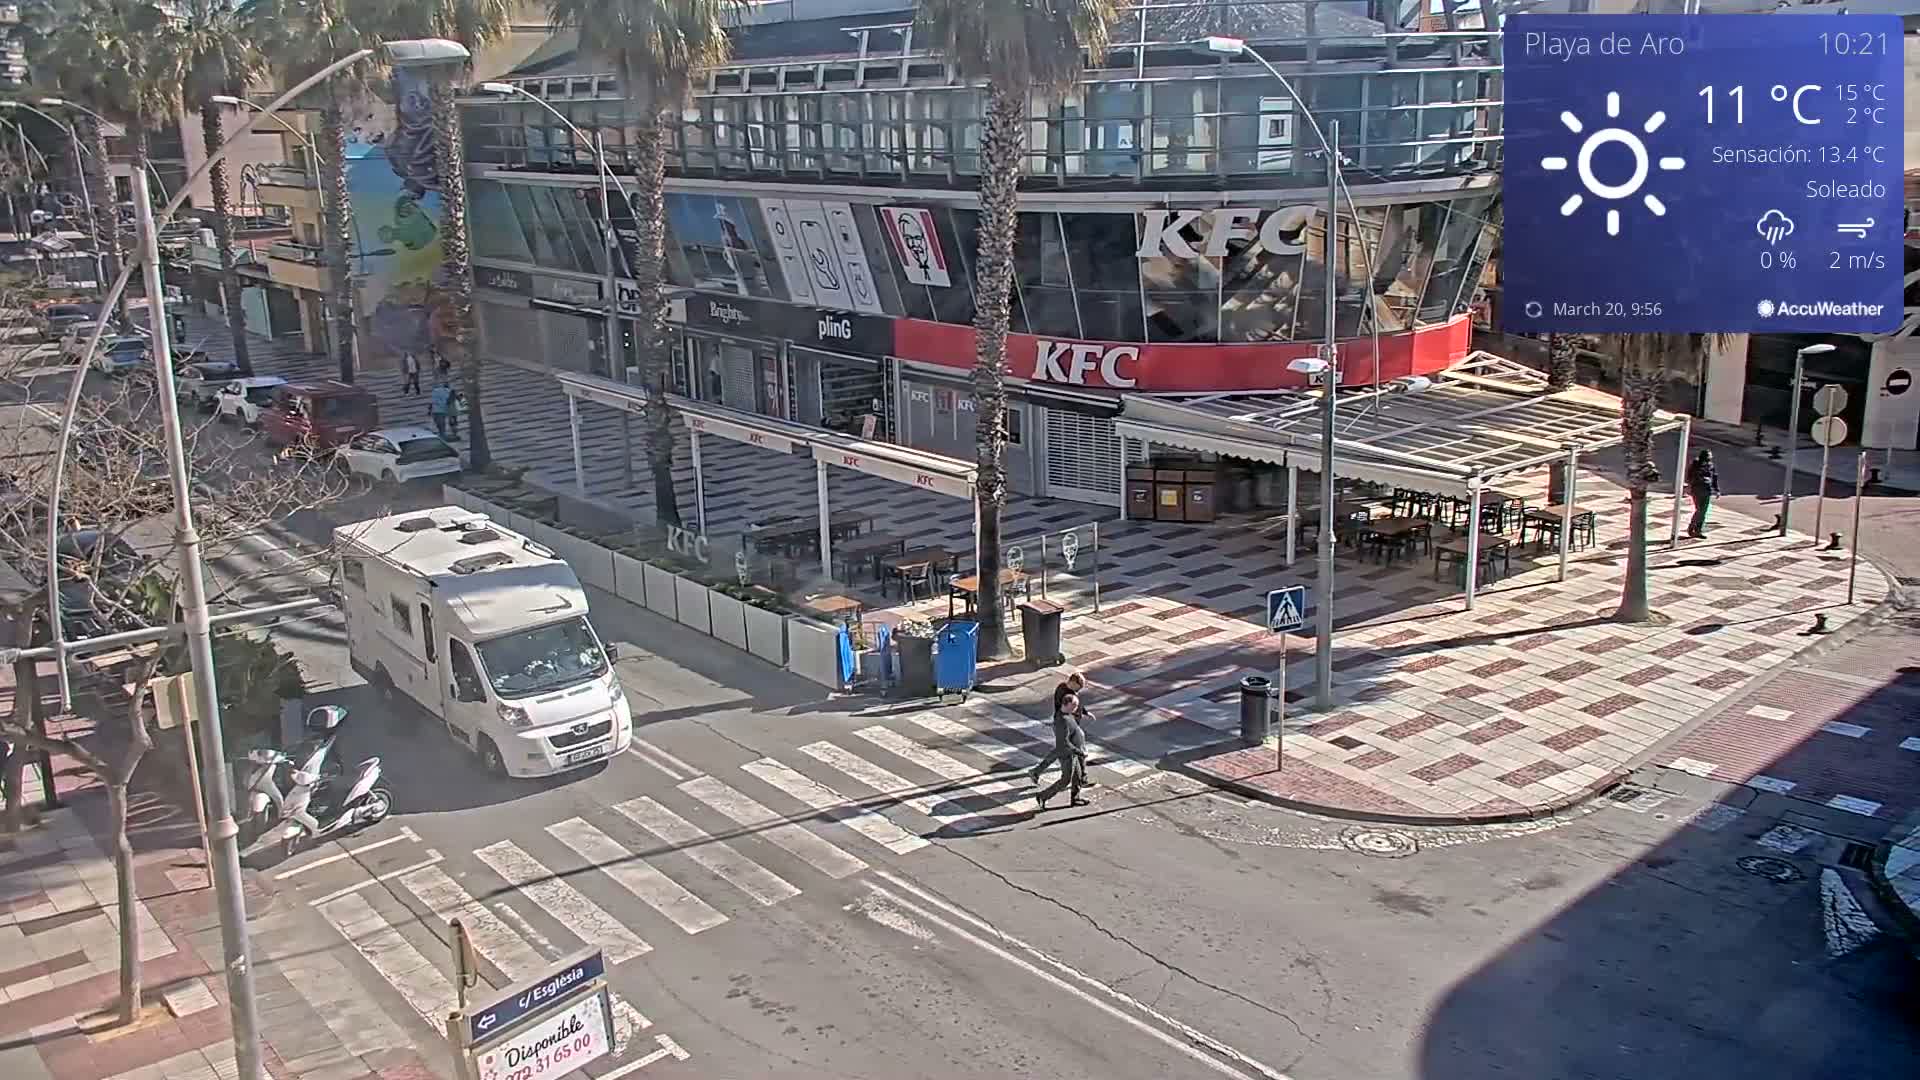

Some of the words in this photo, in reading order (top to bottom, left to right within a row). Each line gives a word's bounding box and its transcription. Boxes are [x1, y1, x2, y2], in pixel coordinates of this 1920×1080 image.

[1136, 204, 1318, 259] KFC
[1031, 339, 1140, 389] KFC
[911, 389, 929, 403] KFC
[843, 456, 860, 468] KFC
[917, 474, 935, 488] KFC
[667, 524, 709, 564] KFC
[504, 1014, 584, 1068] Disponible
[535, 1054, 550, 1073] 31
[574, 1033, 591, 1052] 00
